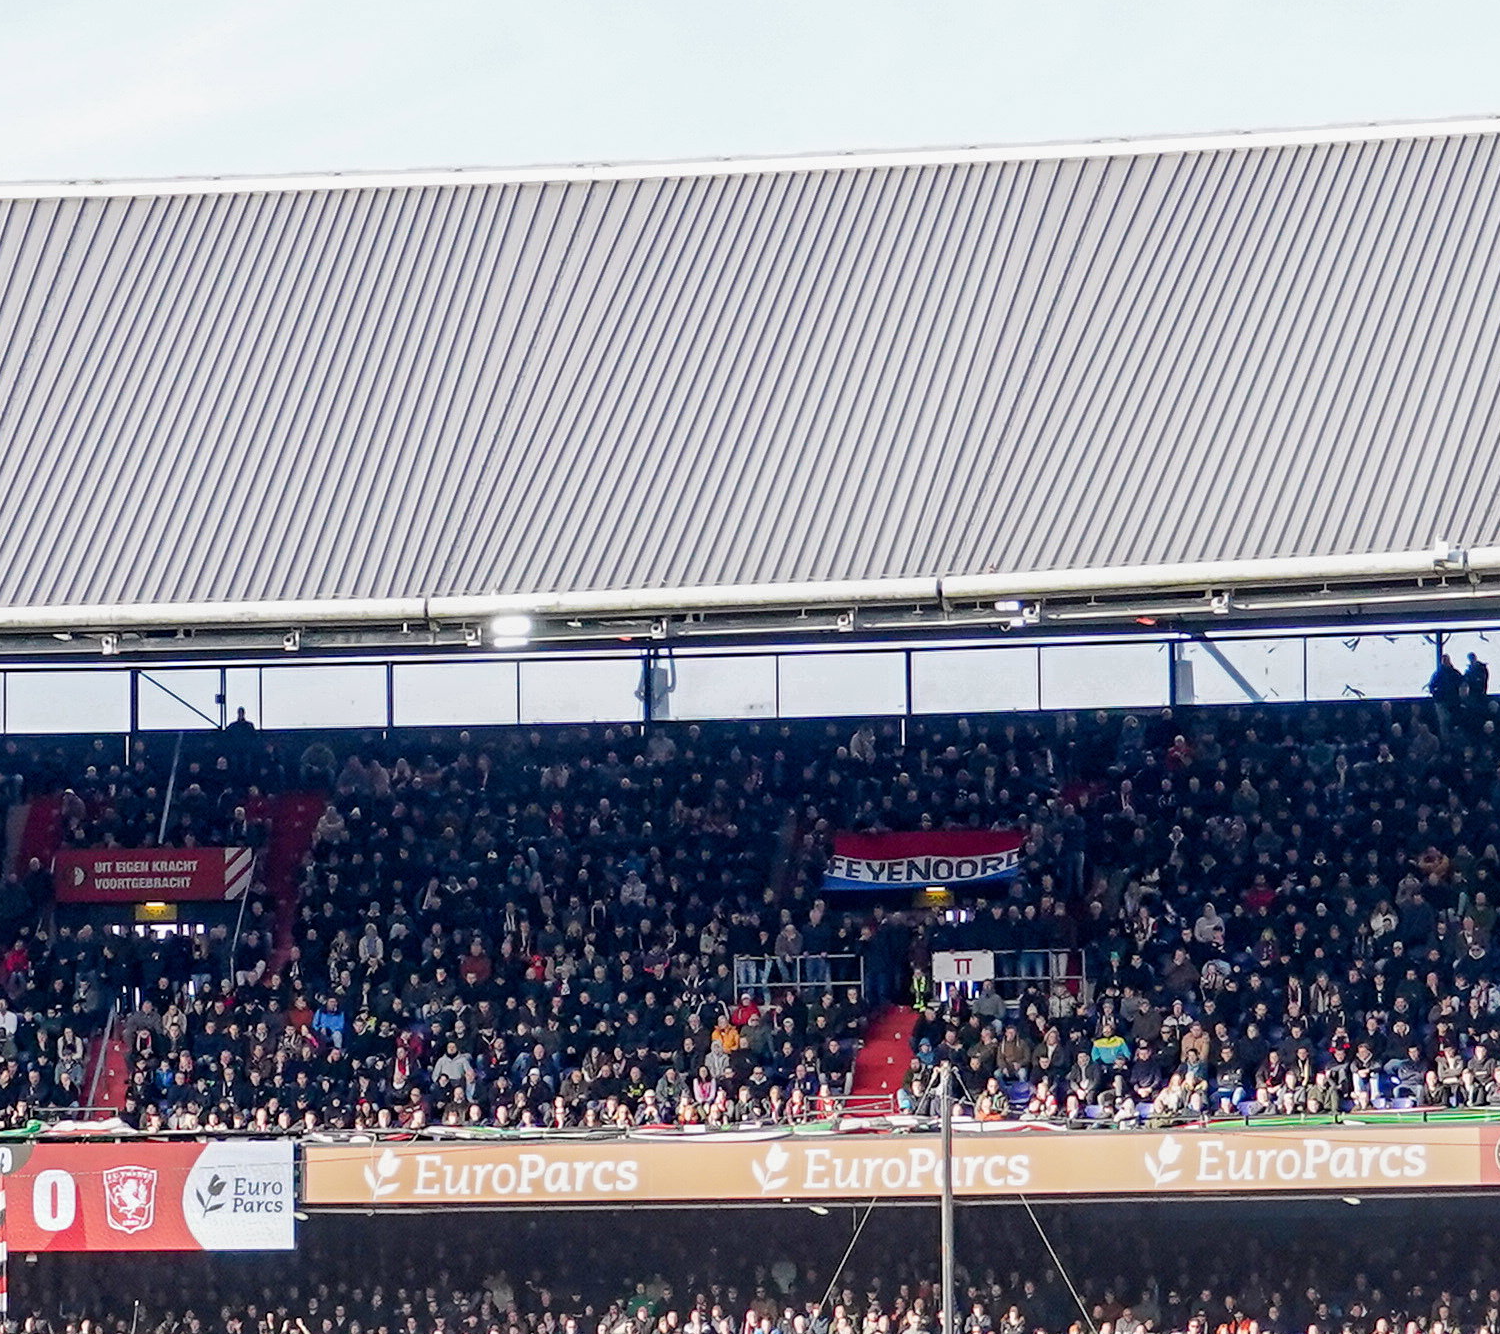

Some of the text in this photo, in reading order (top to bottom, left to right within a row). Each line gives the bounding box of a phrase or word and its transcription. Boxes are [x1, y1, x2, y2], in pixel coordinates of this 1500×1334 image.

[152, 860, 198, 873] KRACHT
[94, 877, 191, 889] VOORTGEBRACHT
[413, 1154, 638, 1196] EuroParcs
[803, 1148, 1030, 1190] EuroParcs
[1196, 1139, 1426, 1183] EuroParcs
[32, 1169, 76, 1231] 0
[234, 1178, 283, 1196] Euro
[233, 1198, 283, 1213] Parcs
